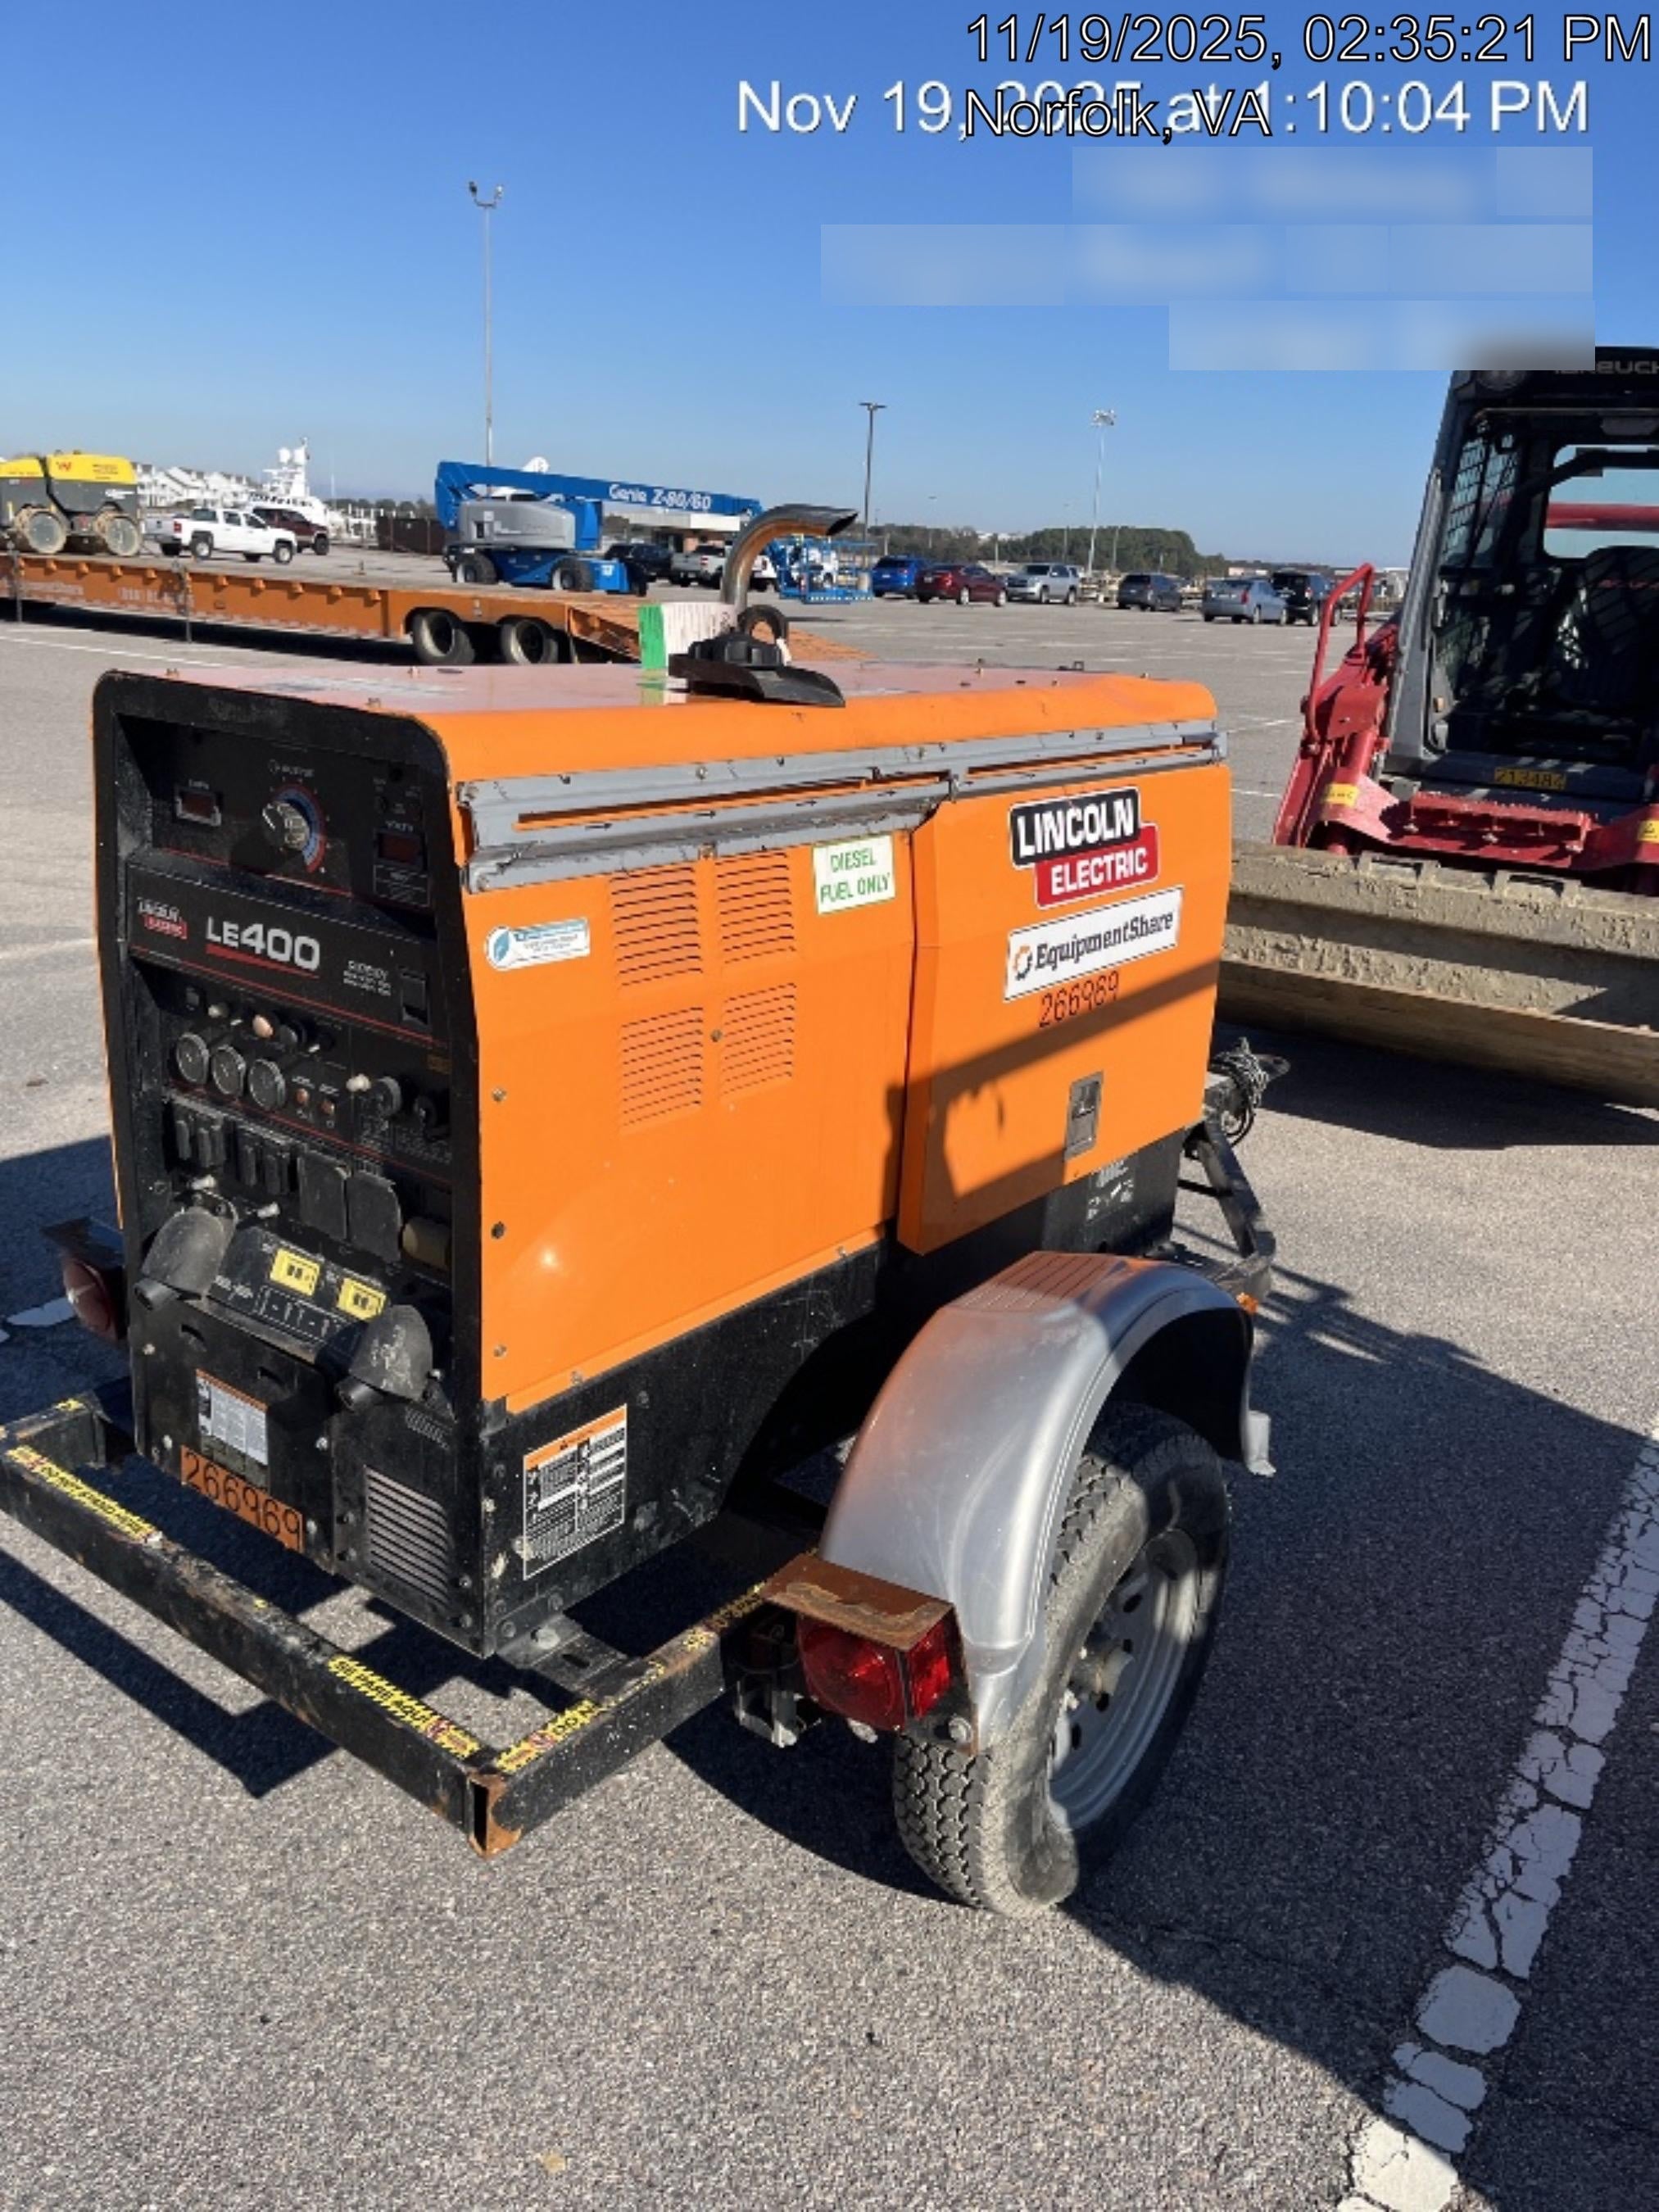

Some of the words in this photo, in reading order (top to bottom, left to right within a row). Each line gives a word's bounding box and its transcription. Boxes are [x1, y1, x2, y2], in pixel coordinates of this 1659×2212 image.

[609, 483, 647, 502] Genie
[1017, 797, 1135, 858] LINCOLN
[830, 848, 876, 873] DIESEL
[1050, 847, 1149, 896] ELECTRIC
[820, 882, 854, 904] FUEL
[857, 873, 891, 895] ONLY
[206, 916, 320, 971] LE400
[1034, 910, 1174, 973] EquipmentShare
[1039, 970, 1120, 1028] 266969
[184, 1451, 301, 1553] 266969
